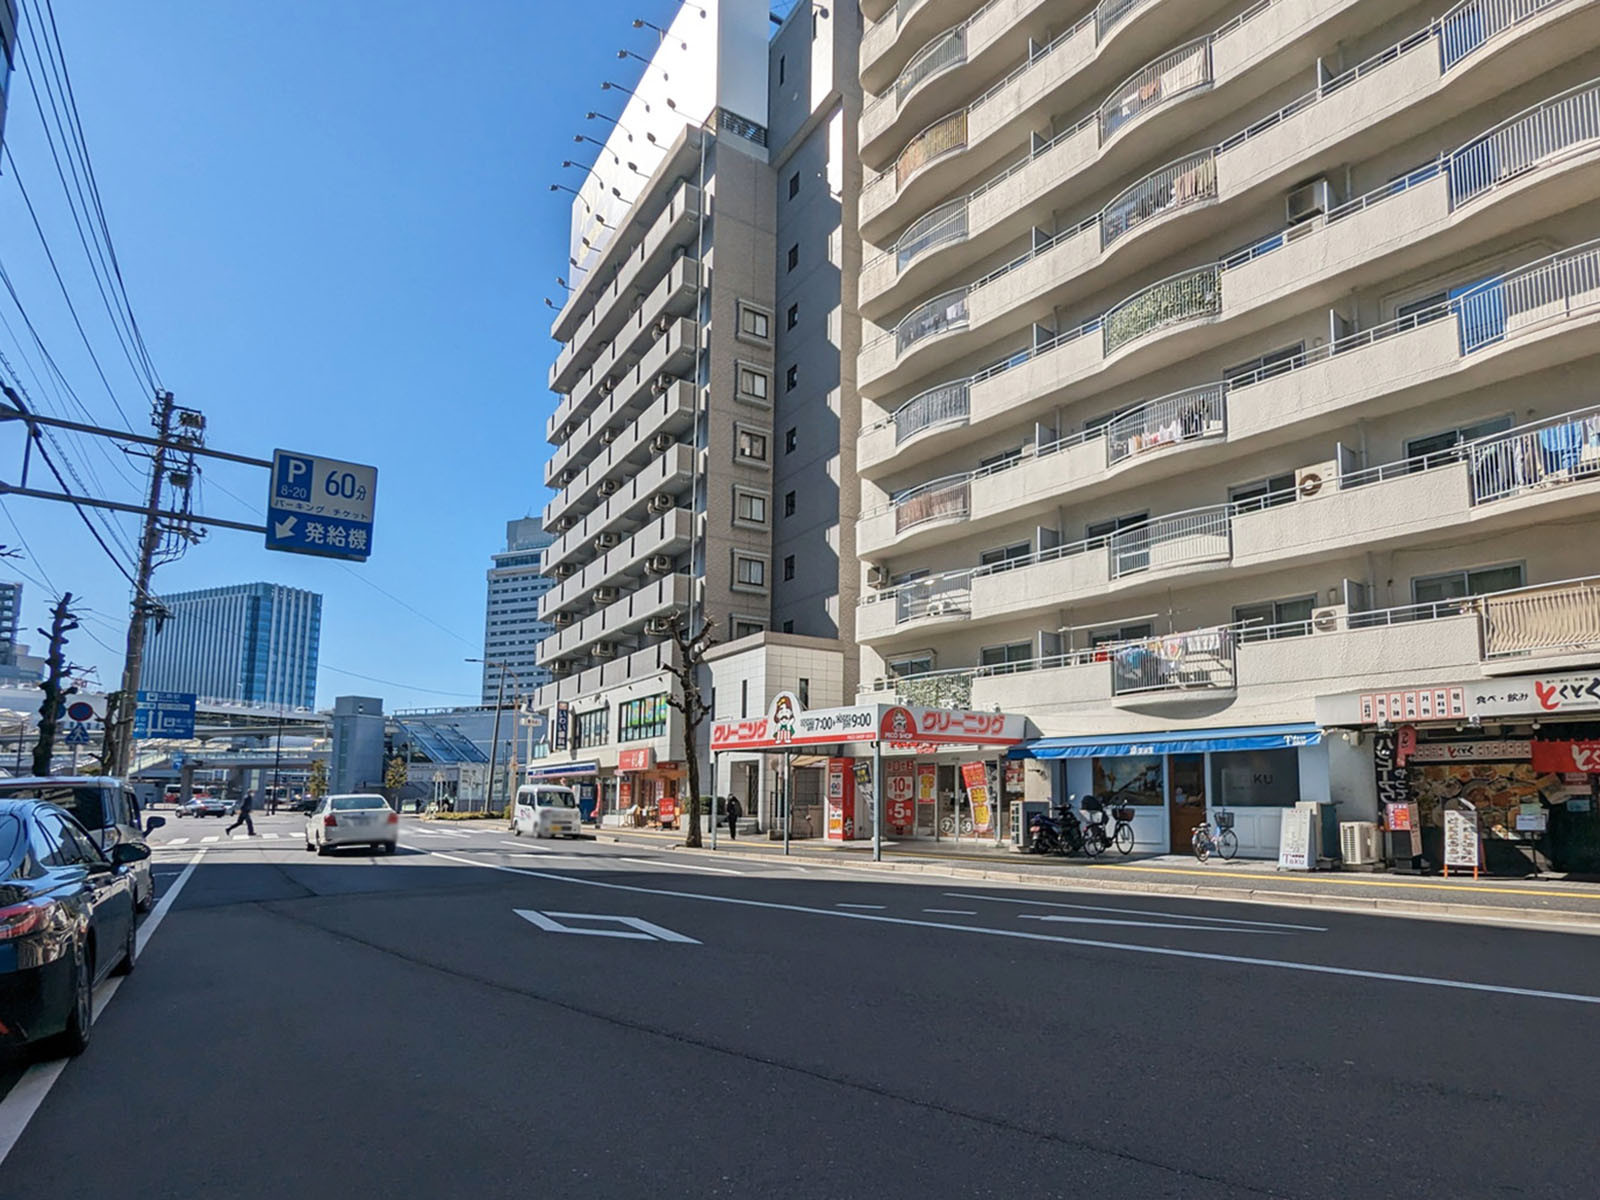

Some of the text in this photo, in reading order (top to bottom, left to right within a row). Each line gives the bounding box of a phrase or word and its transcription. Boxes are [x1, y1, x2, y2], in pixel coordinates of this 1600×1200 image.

[288, 459, 306, 483] P
[280, 485, 307, 498] 8-20
[325, 470, 367, 501] 60分
[305, 521, 368, 550] 発給機
[714, 718, 768, 742] クリーニング
[815, 716, 833, 731] 7:00
[852, 713, 872, 728] 9:00
[922, 711, 1005, 735] クリーニング
